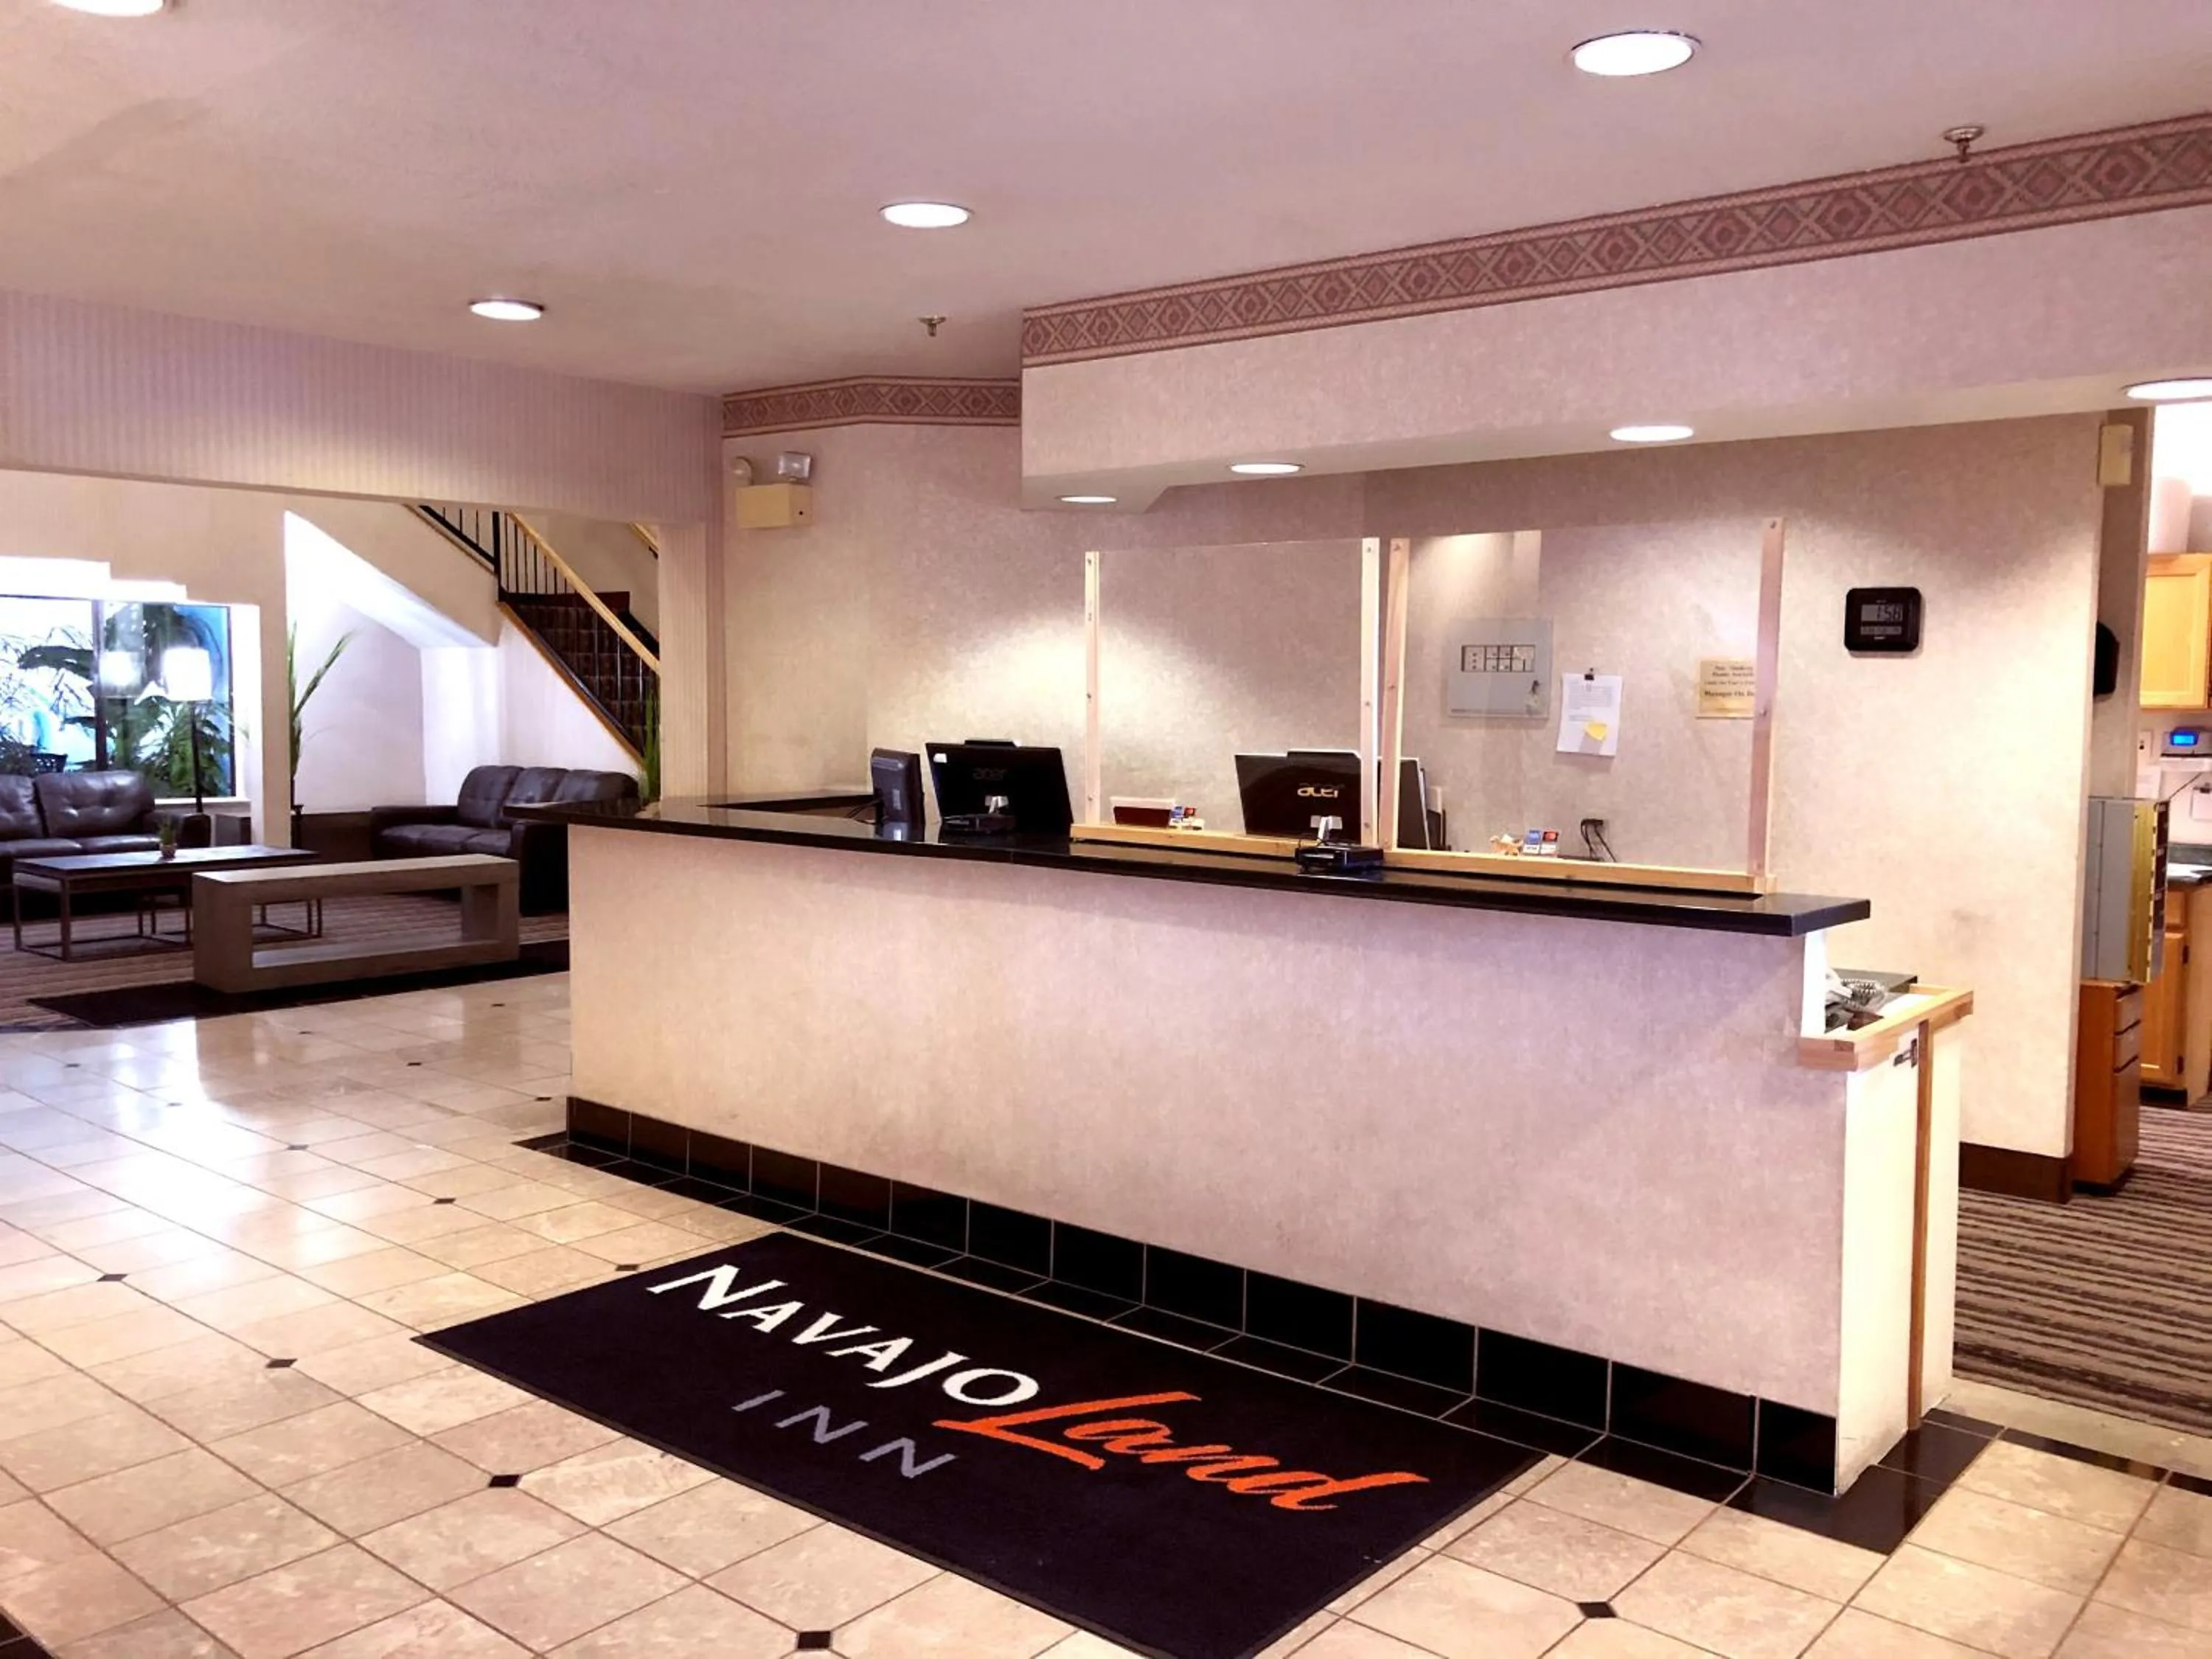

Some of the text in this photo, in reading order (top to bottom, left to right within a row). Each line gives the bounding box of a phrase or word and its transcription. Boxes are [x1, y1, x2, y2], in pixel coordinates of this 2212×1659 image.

[646, 1263, 1430, 1511] NAVAJO Land
[731, 1389, 958, 1479] INN
